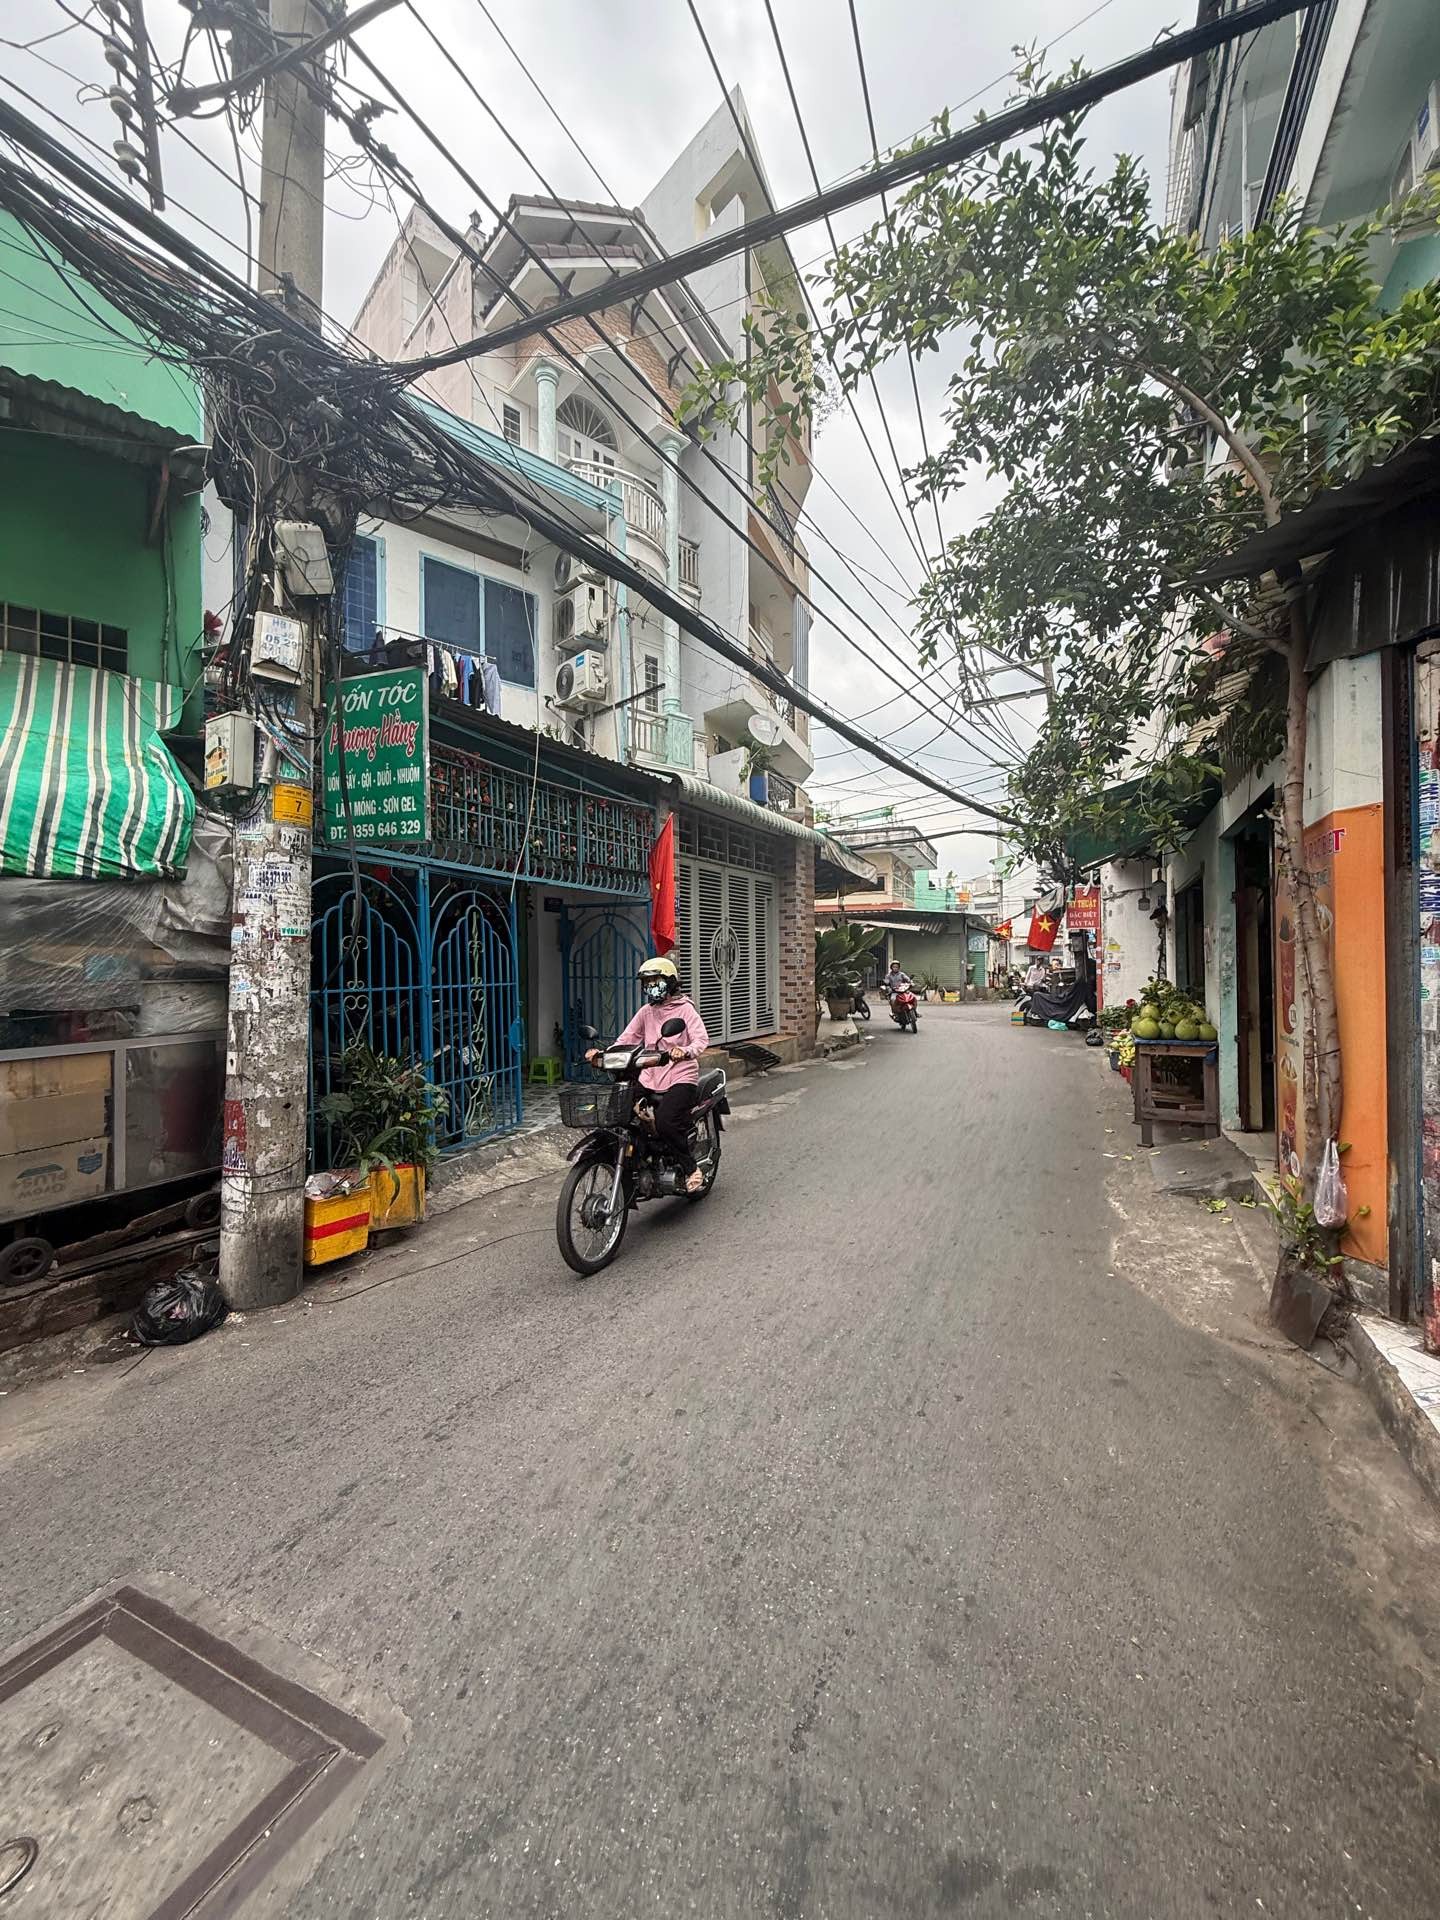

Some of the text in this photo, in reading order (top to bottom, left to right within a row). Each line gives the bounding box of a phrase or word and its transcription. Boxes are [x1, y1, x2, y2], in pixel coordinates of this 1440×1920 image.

[378, 680, 417, 707] TÓC
[327, 771, 340, 791] UỐN
[361, 768, 372, 791] GỘI
[377, 763, 392, 786] DUỖI
[397, 763, 420, 787] NHUỘM
[296, 800, 302, 813] 7
[354, 797, 377, 816] MÓNG
[383, 796, 399, 814] SƠN
[401, 796, 417, 812] GEL
[330, 826, 347, 840] ĐT:
[377, 821, 397, 837] 646
[400, 819, 421, 835] 329
